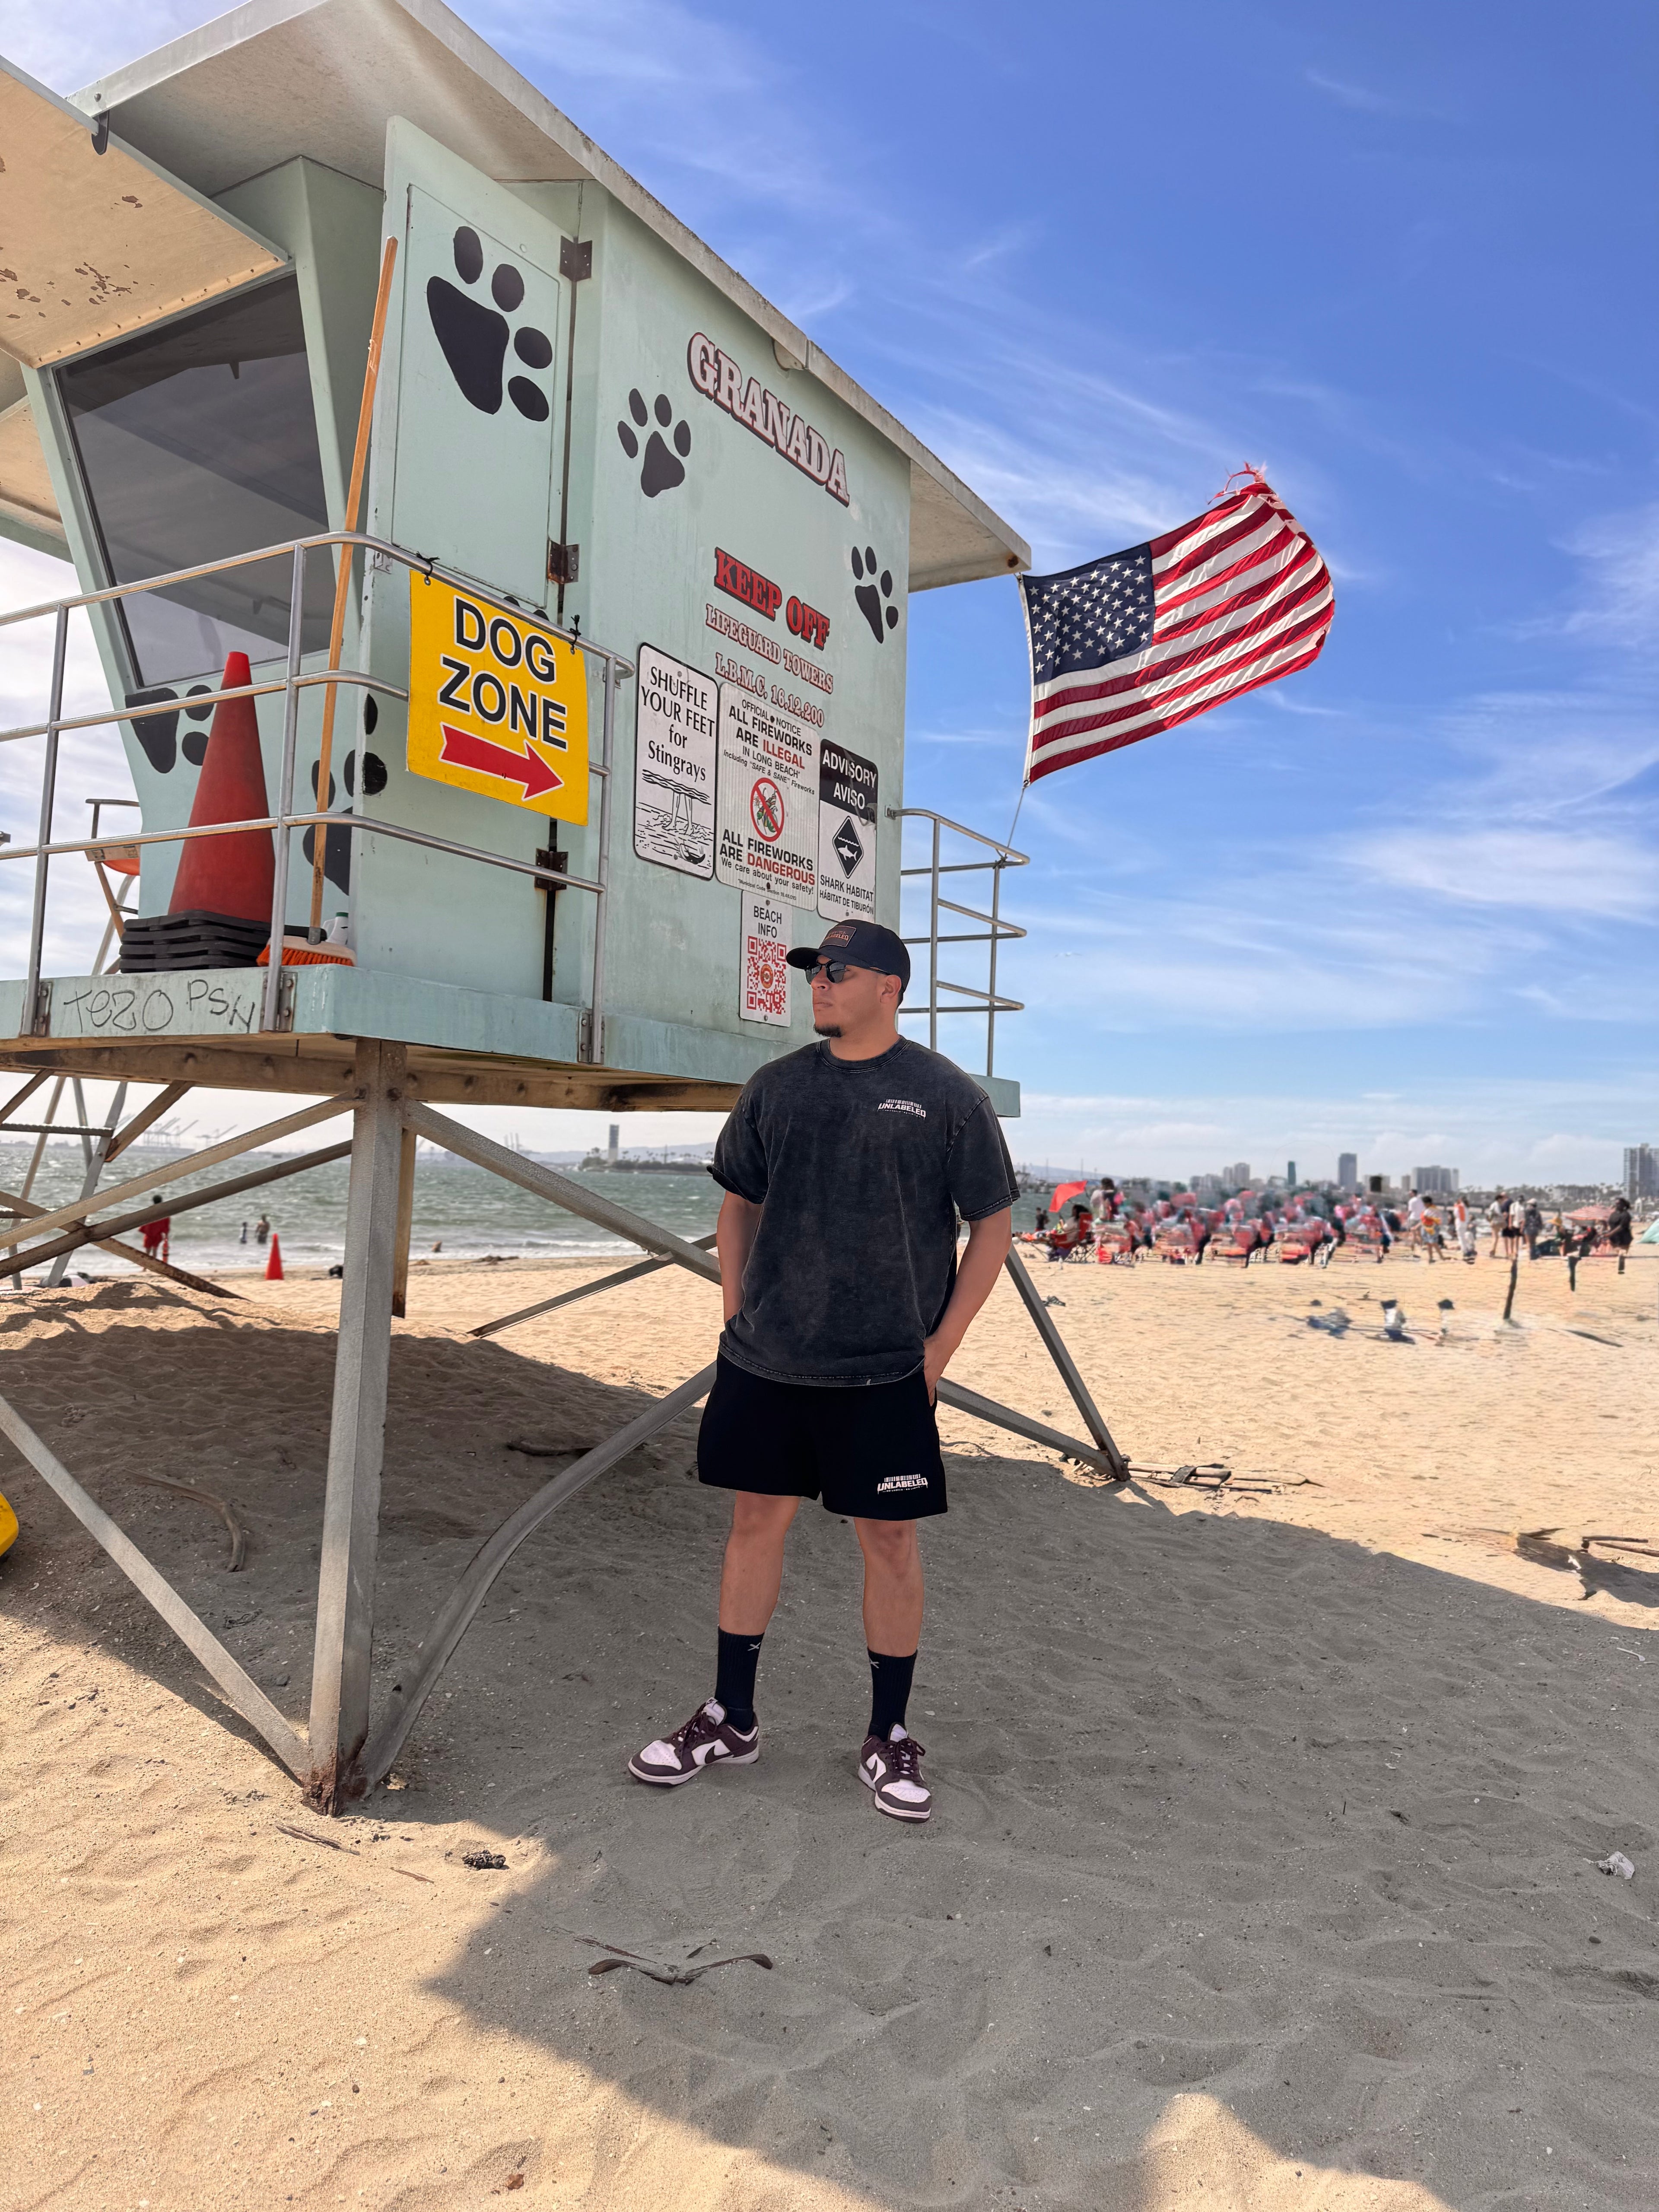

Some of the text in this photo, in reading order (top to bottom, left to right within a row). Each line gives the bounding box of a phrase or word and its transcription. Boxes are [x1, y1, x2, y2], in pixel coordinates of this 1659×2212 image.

[688, 332, 849, 507] GRANADA
[714, 547, 830, 651] KEEP OFF
[454, 595, 556, 685] DOG
[706, 604, 833, 694] LIFEGUARD TOWERS
[437, 654, 568, 752] ZONE
[650, 666, 707, 711] SHUFFLE
[715, 652, 824, 728] L.B.M.C. 16.12.200
[641, 685, 715, 737] YOUR FEET
[729, 705, 812, 756] ALL FIREWORKS
[742, 699, 801, 737] OFFICIAL NOTICE
[669, 724, 687, 748] for
[736, 727, 805, 770] ARE ILLEGAL
[743, 745, 750, 756] IN
[753, 750, 772, 767] LONG
[648, 740, 706, 782] Stingrays
[724, 750, 747, 767] Including
[791, 780, 815, 795] Fireworks
[822, 749, 877, 788] ADVISORY
[833, 782, 865, 810] AVISO
[720, 843, 815, 885] ARE DANGEROUS
[723, 829, 813, 871] ALL FIREWORKS
[721, 857, 814, 894] We care about your safety!
[820, 874, 874, 902] SHARK HABITAT
[753, 906, 782, 925] BEACH
[820, 889, 874, 915] HÁBITAT DE TIBURÓN
[758, 922, 777, 938] INFO
[877, 1103, 926, 1120] UNLABELED
[877, 1477, 928, 1495] UNLABELED
